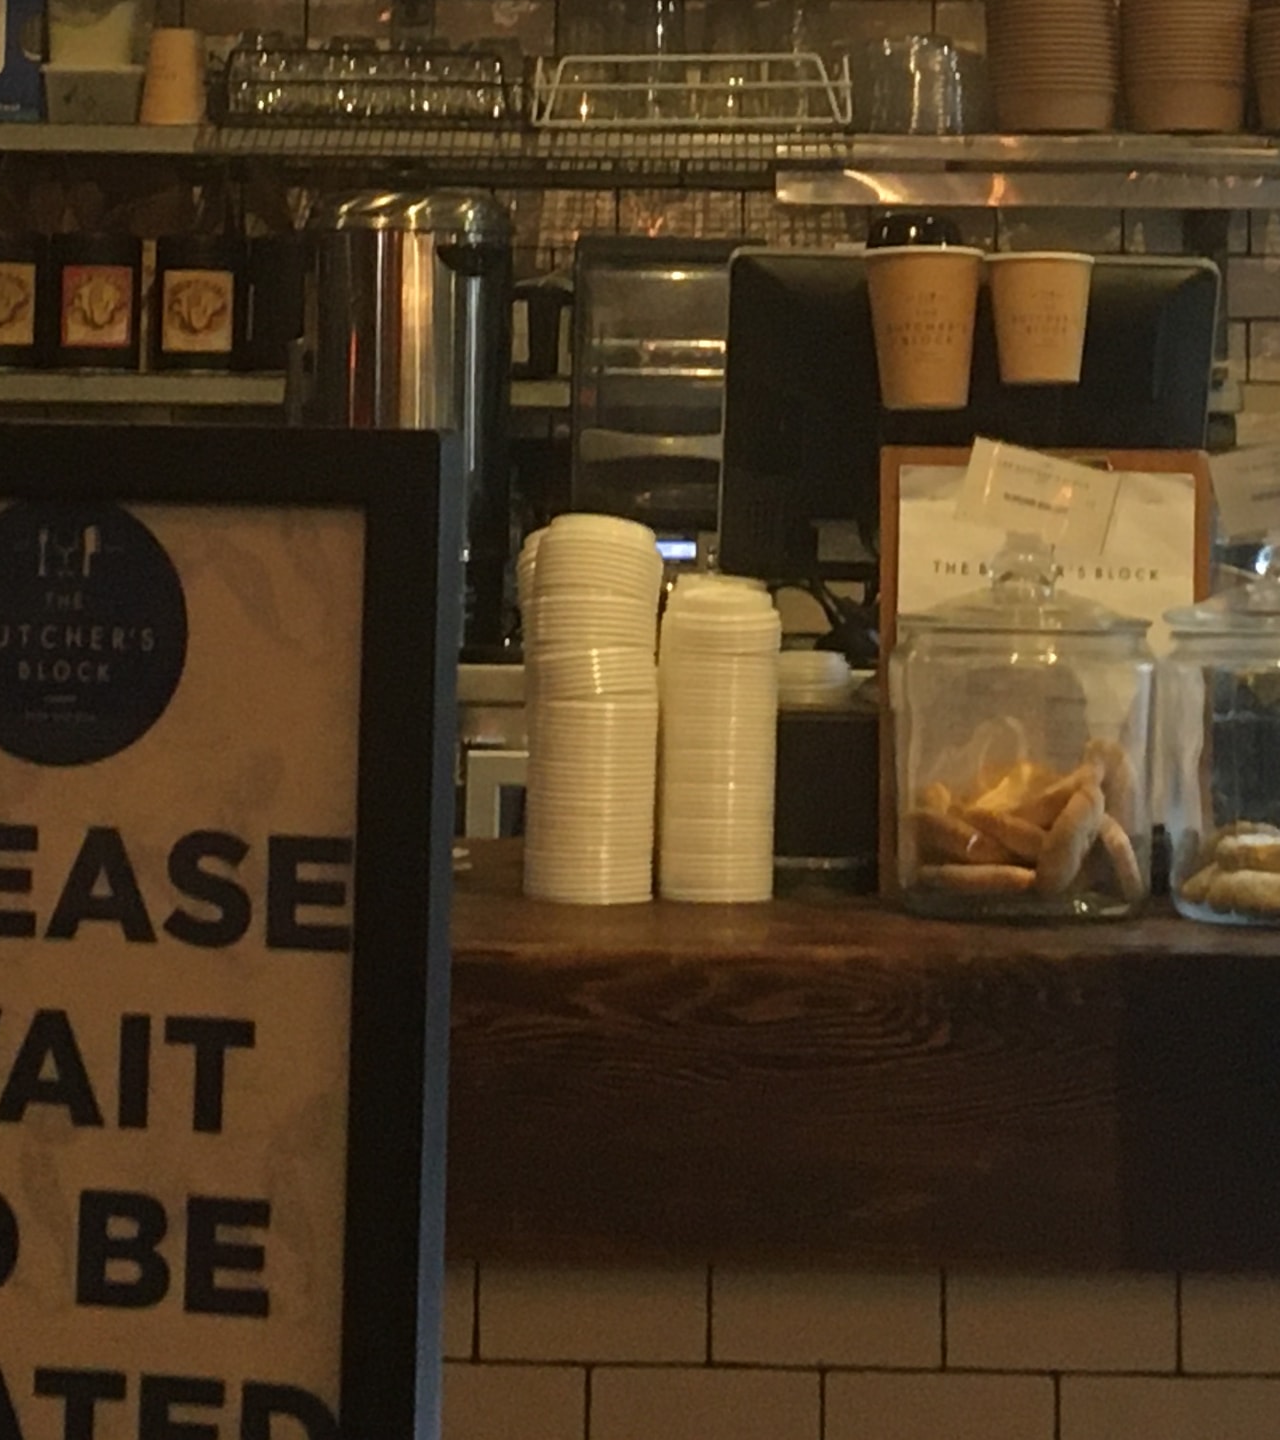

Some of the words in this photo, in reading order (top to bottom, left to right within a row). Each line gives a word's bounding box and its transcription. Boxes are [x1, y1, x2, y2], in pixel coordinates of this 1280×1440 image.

[933, 560, 969, 575] THE
[1094, 567, 1160, 582] BLOCK
[46, 591, 82, 610] THE
[18, 661, 110, 683] BLOCK
[75, 1189, 271, 1319] BE
